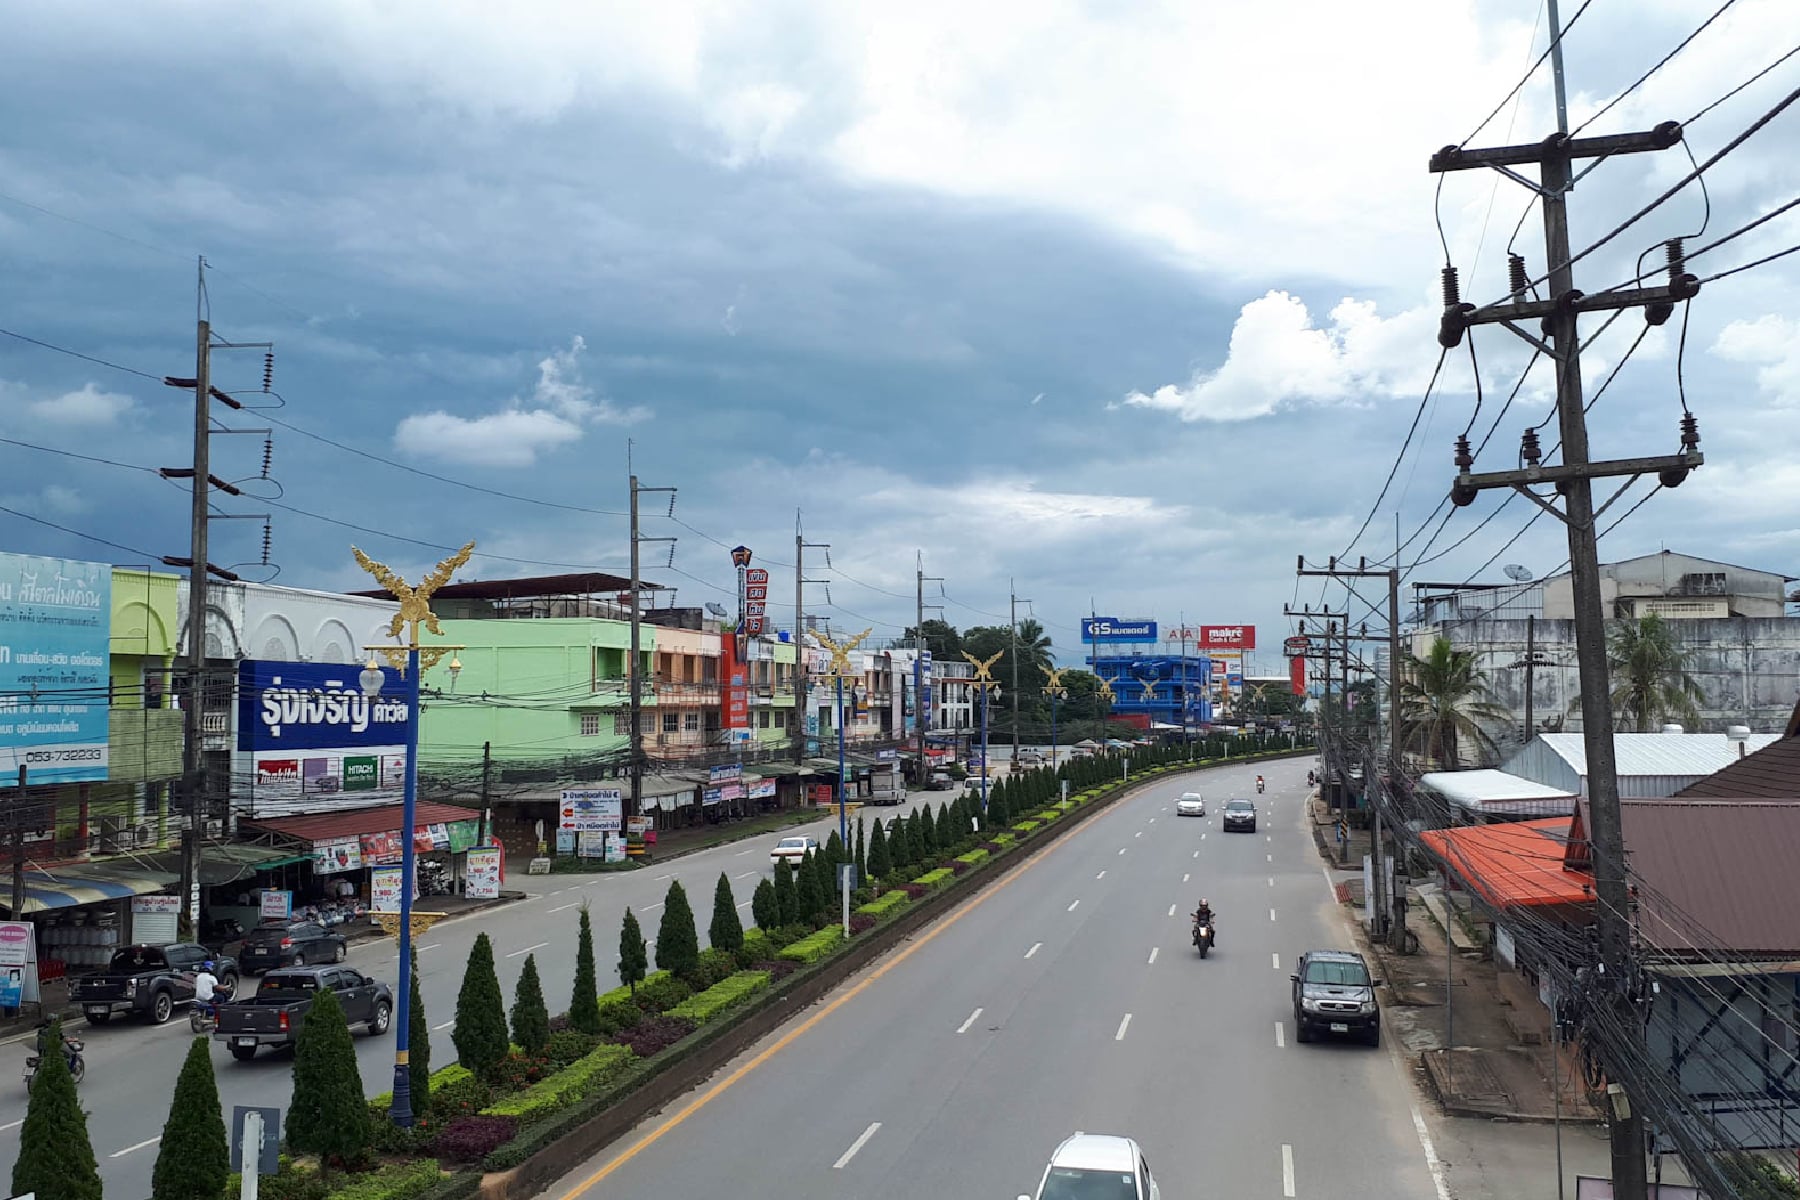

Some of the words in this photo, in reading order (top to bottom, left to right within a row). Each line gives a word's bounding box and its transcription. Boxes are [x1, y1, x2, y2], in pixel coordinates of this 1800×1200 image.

[261, 676, 369, 737] รุ่งเจริญ
[26, 750, 101, 762] 053-732233
